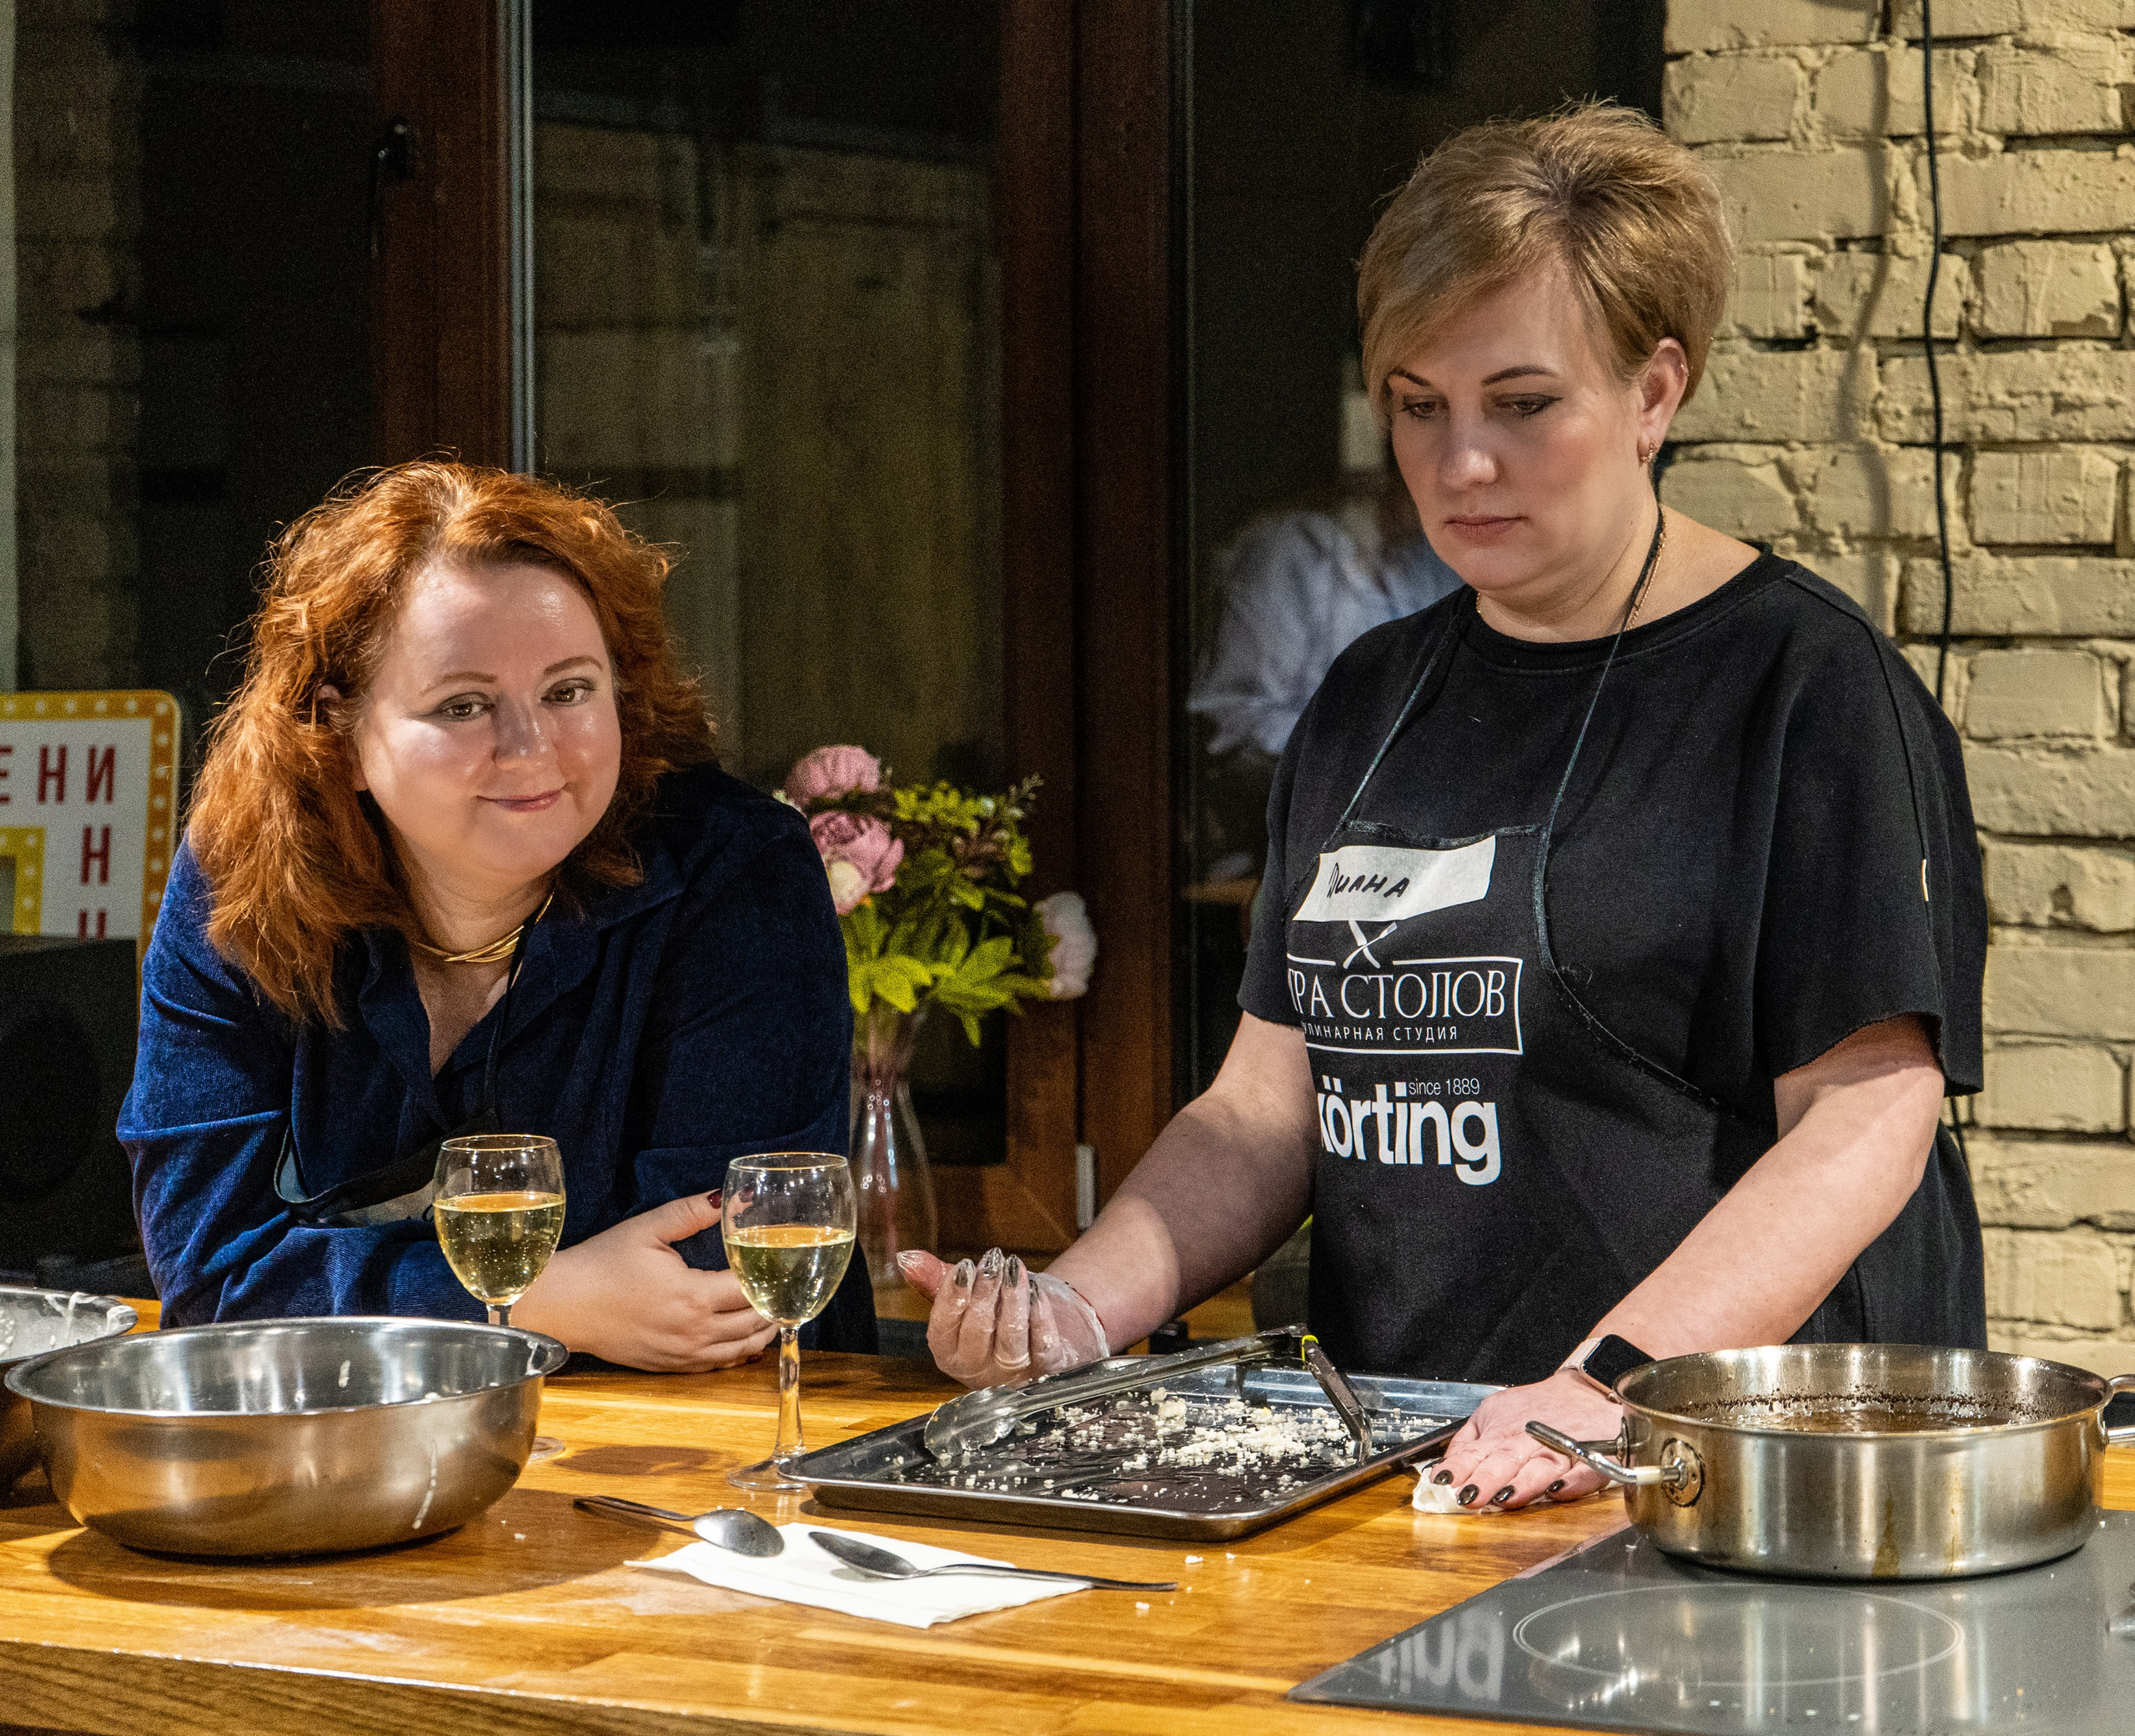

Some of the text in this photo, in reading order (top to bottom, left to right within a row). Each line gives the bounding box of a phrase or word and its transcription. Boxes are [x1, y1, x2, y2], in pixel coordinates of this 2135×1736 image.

[1340, 970, 1506, 1019] СТОЛОВ
[1393, 1026, 1458, 1042] СТУДИЯ
[1409, 1077, 1480, 1096] since 1889
